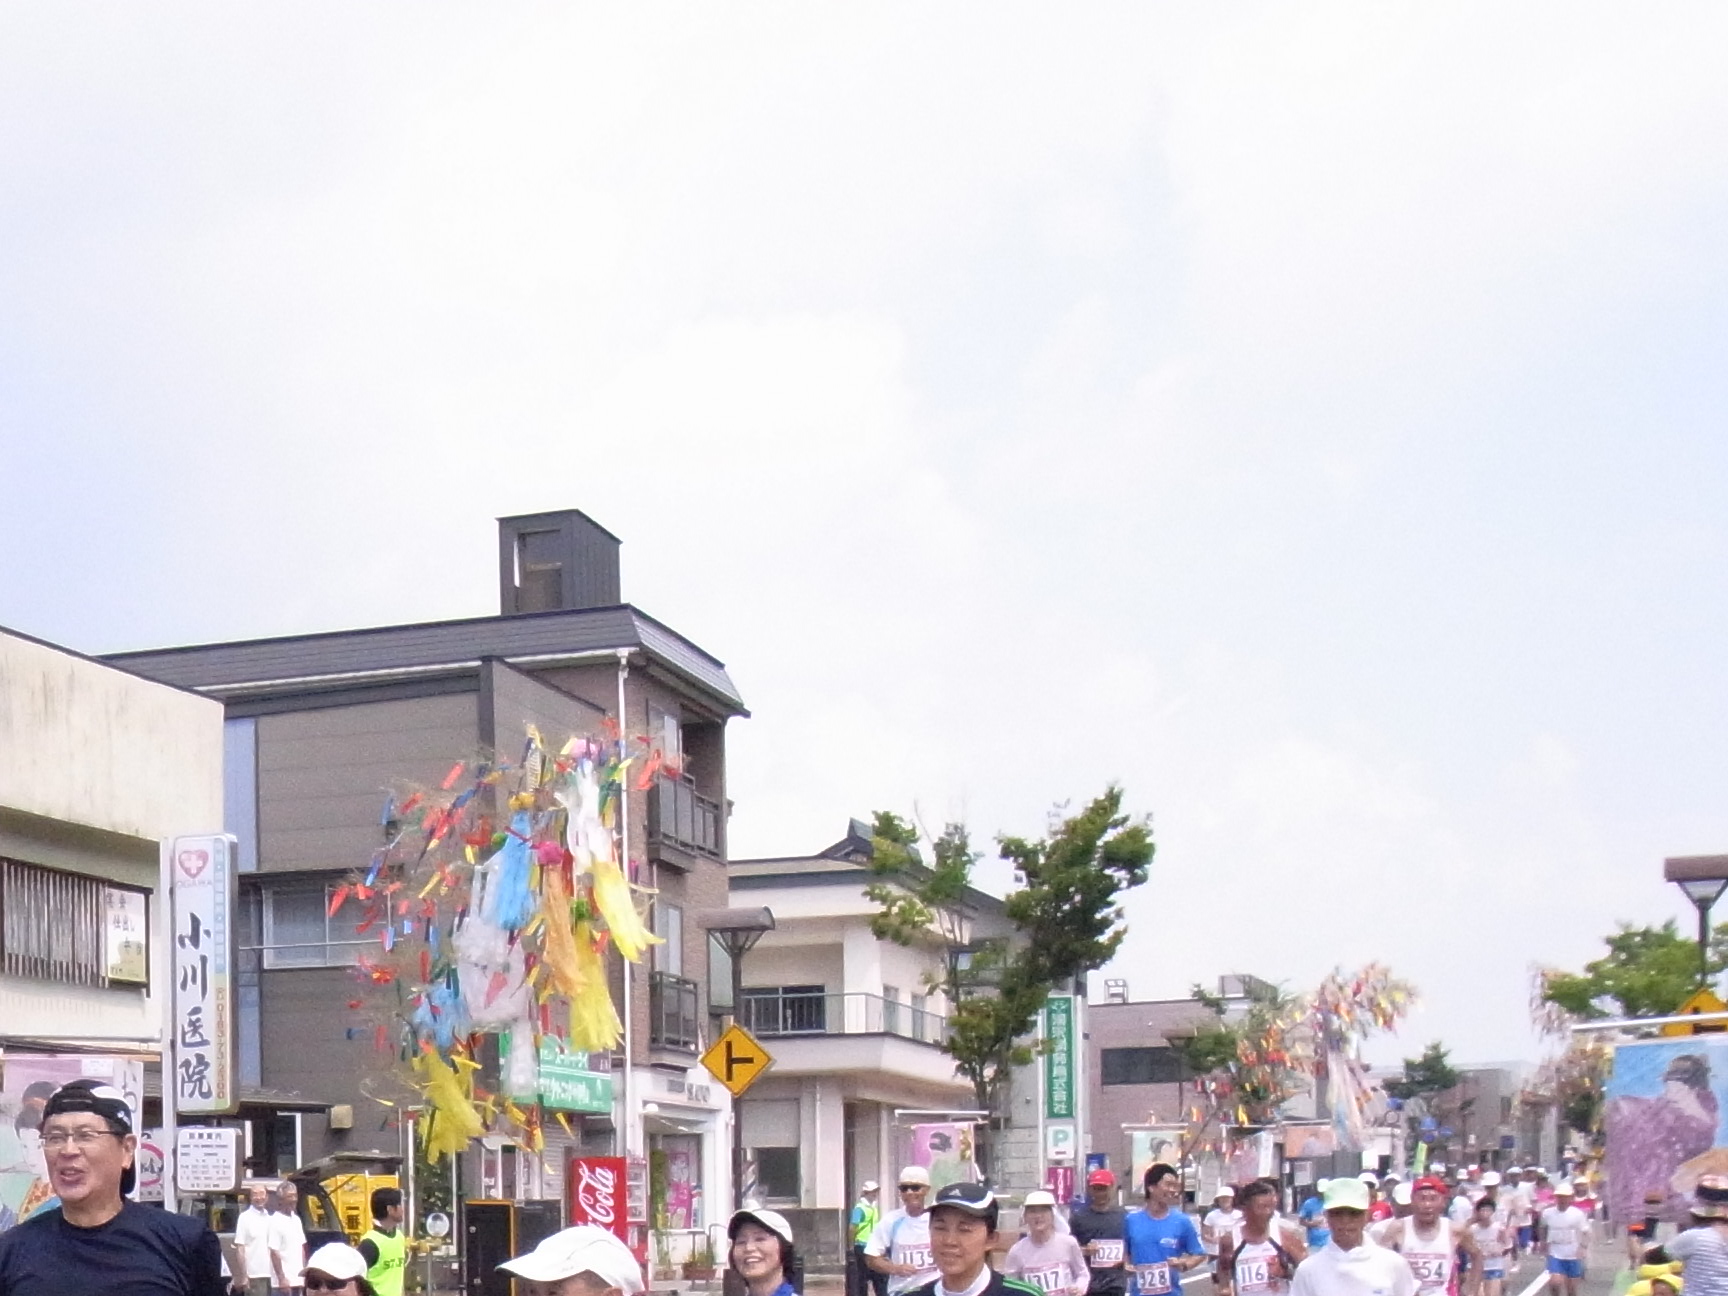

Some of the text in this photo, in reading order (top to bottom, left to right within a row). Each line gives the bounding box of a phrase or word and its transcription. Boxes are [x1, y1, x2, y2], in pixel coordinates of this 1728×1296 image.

[177, 912, 213, 1100] 小川医院
[1052, 1128, 1069, 1147] P
[1241, 1264, 1266, 1284] 116
